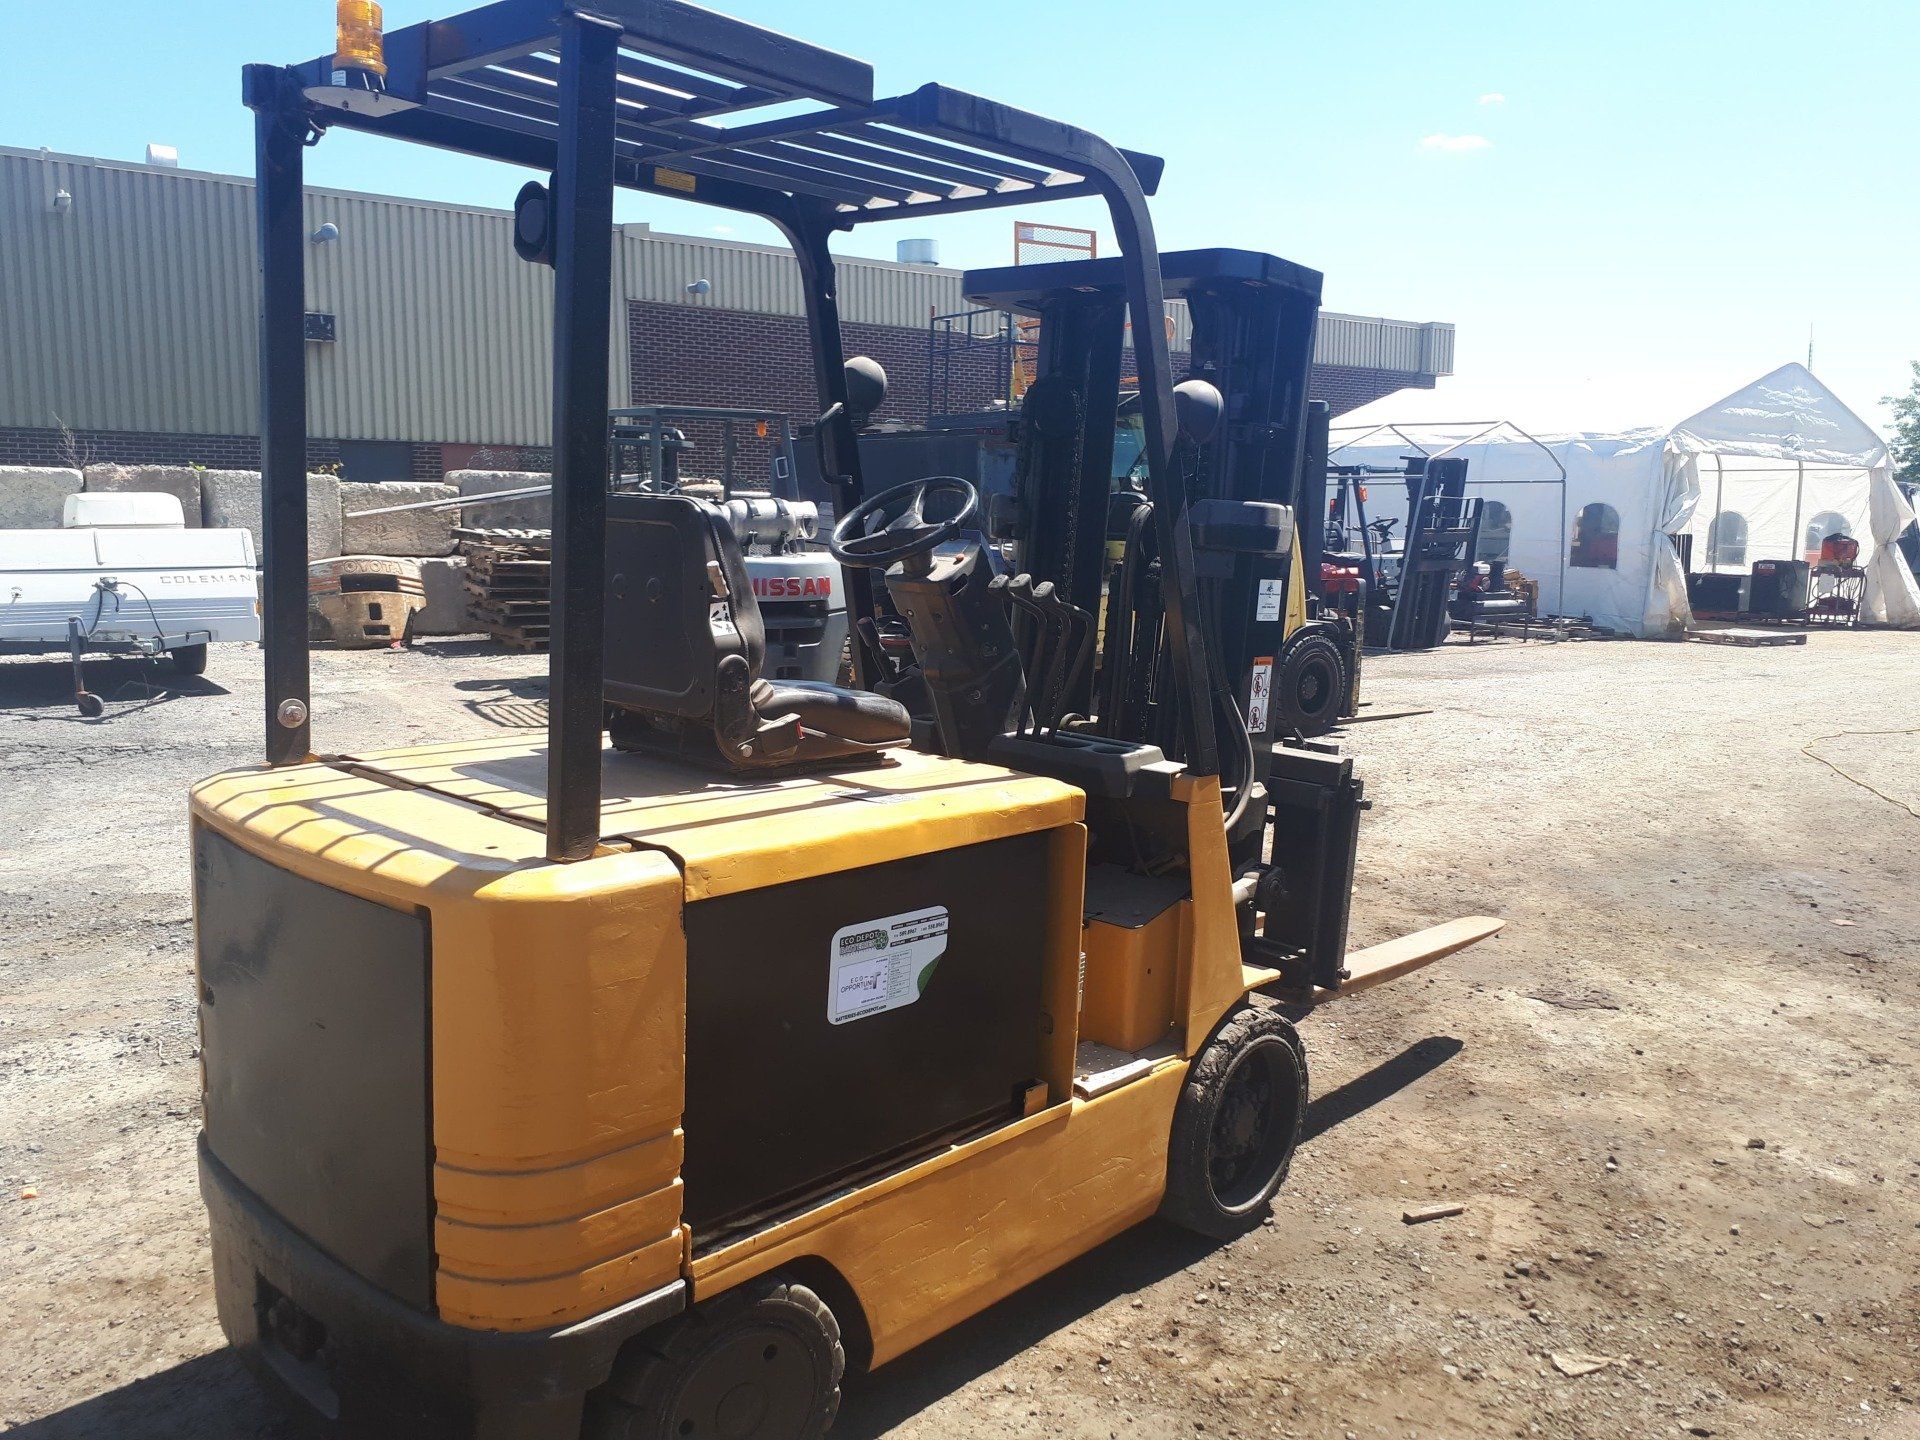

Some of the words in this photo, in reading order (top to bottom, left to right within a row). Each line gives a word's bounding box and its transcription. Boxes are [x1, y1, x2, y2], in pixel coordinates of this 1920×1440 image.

[159, 574, 252, 584] COLEMAN
[840, 936, 855, 946] ECO
[857, 931, 880, 943] DEPOT
